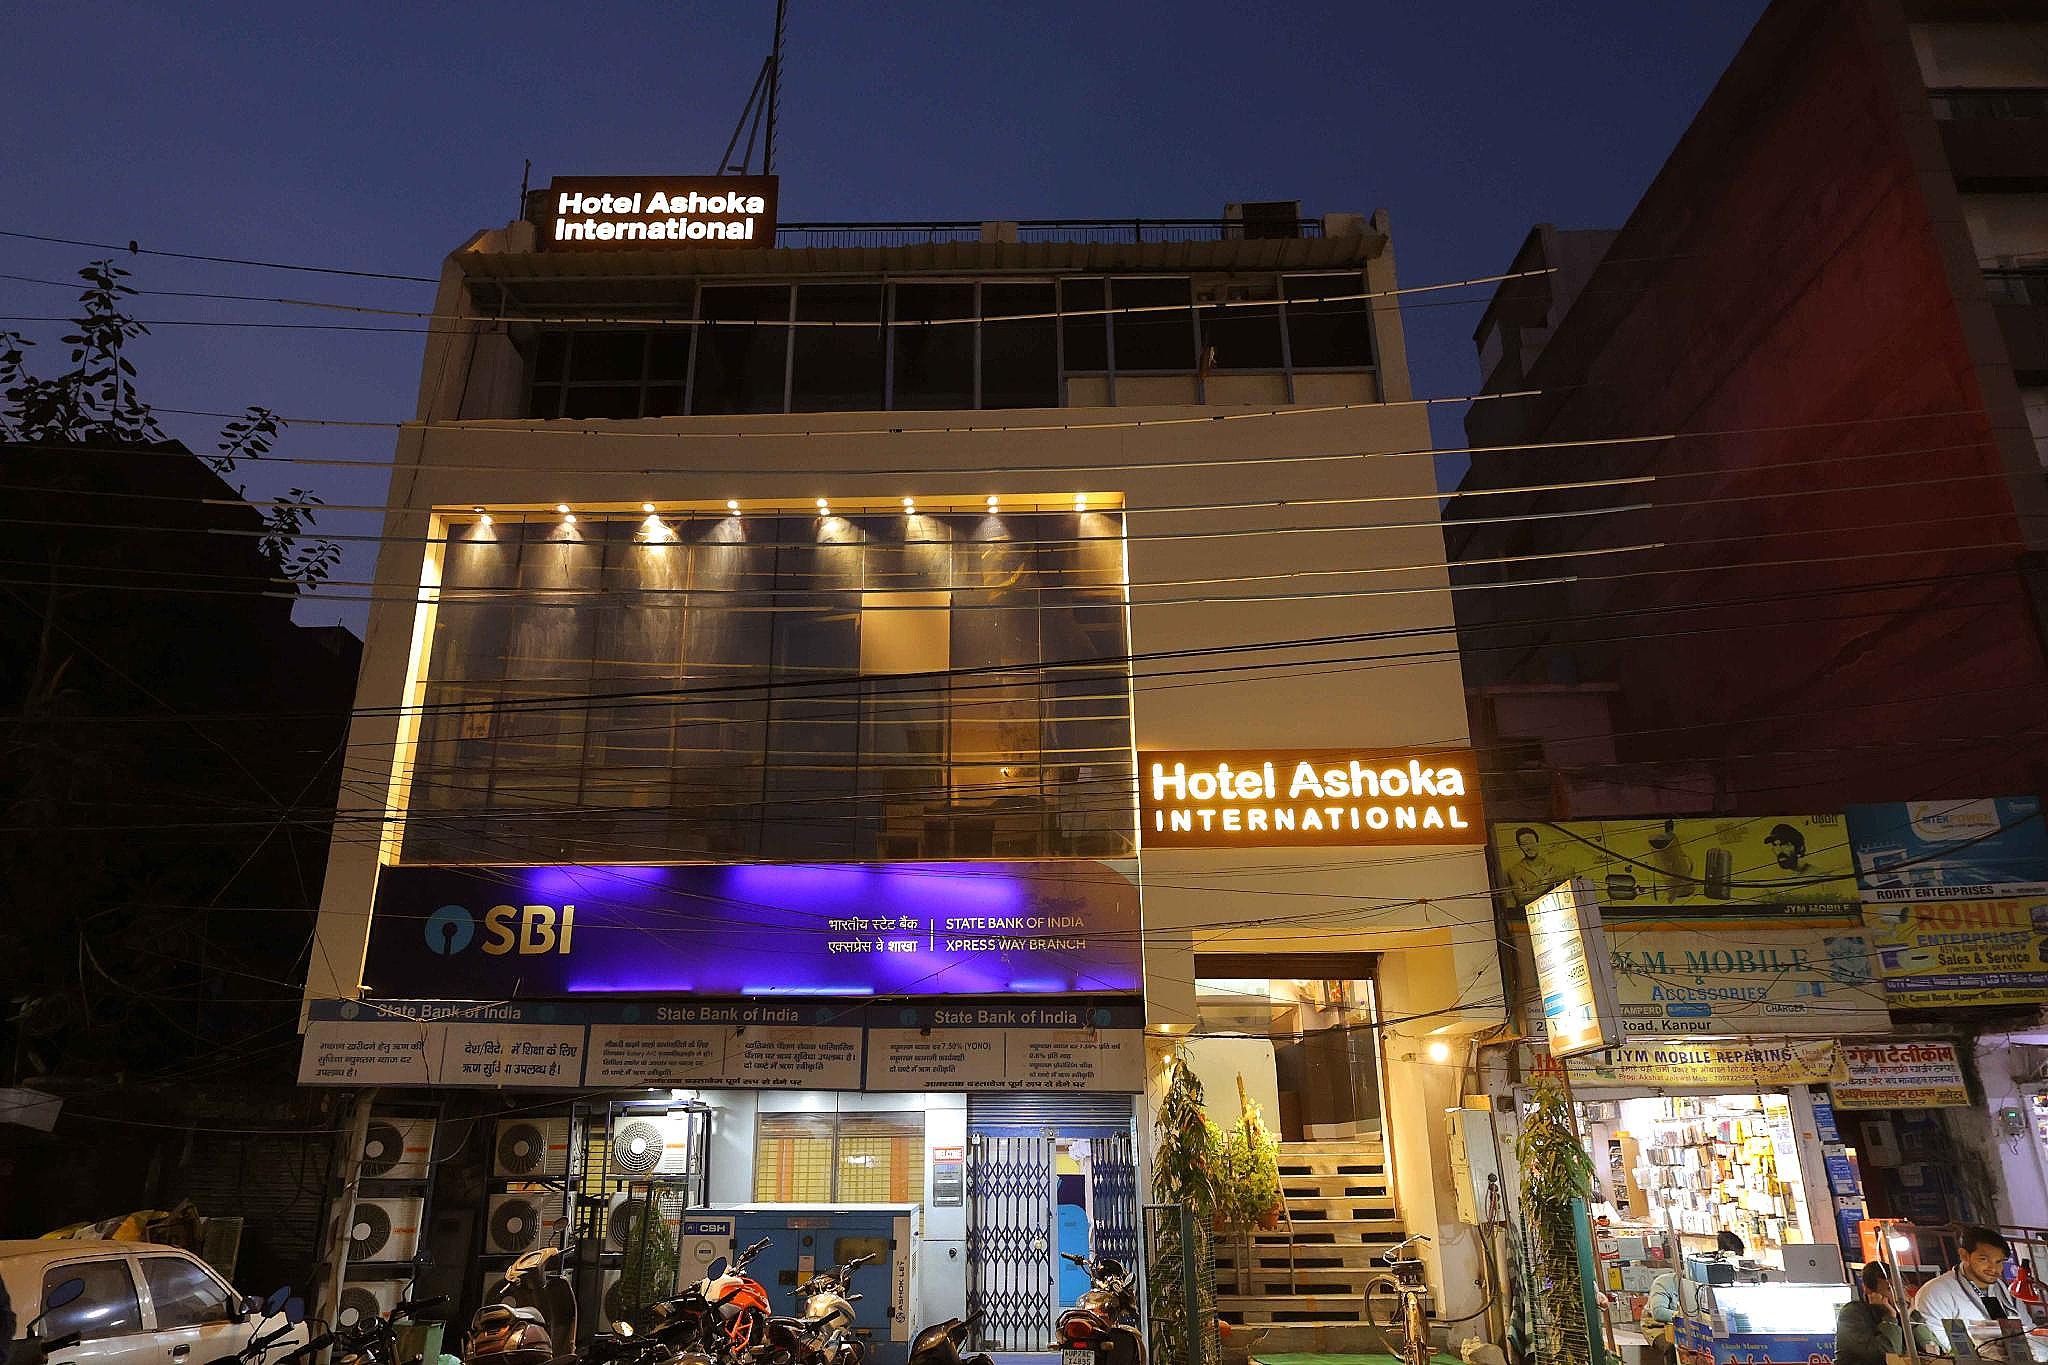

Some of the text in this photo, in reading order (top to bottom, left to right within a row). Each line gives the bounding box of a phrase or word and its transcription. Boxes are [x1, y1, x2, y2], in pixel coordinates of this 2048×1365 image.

[558, 191, 764, 214] Hotel Ashoka
[555, 217, 754, 240] International
[1152, 760, 1465, 800] Hotel Ashoka
[1155, 806, 1468, 831] INTERNATIONAL
[1877, 889, 1911, 899] ROHIT
[1915, 886, 1994, 897] ENTERPRISES
[828, 915, 919, 931] भारतीय स्टेट बैंक
[945, 916, 1085, 930] STATE BANK OF INDIA
[1914, 902, 2018, 930] ROHIT
[480, 905, 575, 956] SBI
[827, 937, 919, 954] एक्सप्रेस वे शाखा
[945, 938, 1086, 951] XPRESS WAY BRANCH
[1686, 949, 1811, 974] MOBILE
[1938, 951, 2030, 965] Sales & Service
[376, 1003, 521, 1020] State Bank of India
[656, 1007, 799, 1022] State Bank of India
[934, 1010, 1078, 1024] State Bank of India
[1661, 1020, 1712, 1033] Kanpur
[523, 1041, 545, 1056] शिक्षा
[546, 1043, 558, 1056] के
[559, 1042, 578, 1057] लिए
[964, 1042, 992, 1052] (YONO)
[1848, 1046, 1886, 1064] गंगा
[1887, 1044, 1954, 1064] टेलीकॉम
[1616, 1050, 1649, 1063] JYM
[1655, 1050, 1712, 1064] MOBILE
[513, 1064, 547, 1075] उपलब्ध
